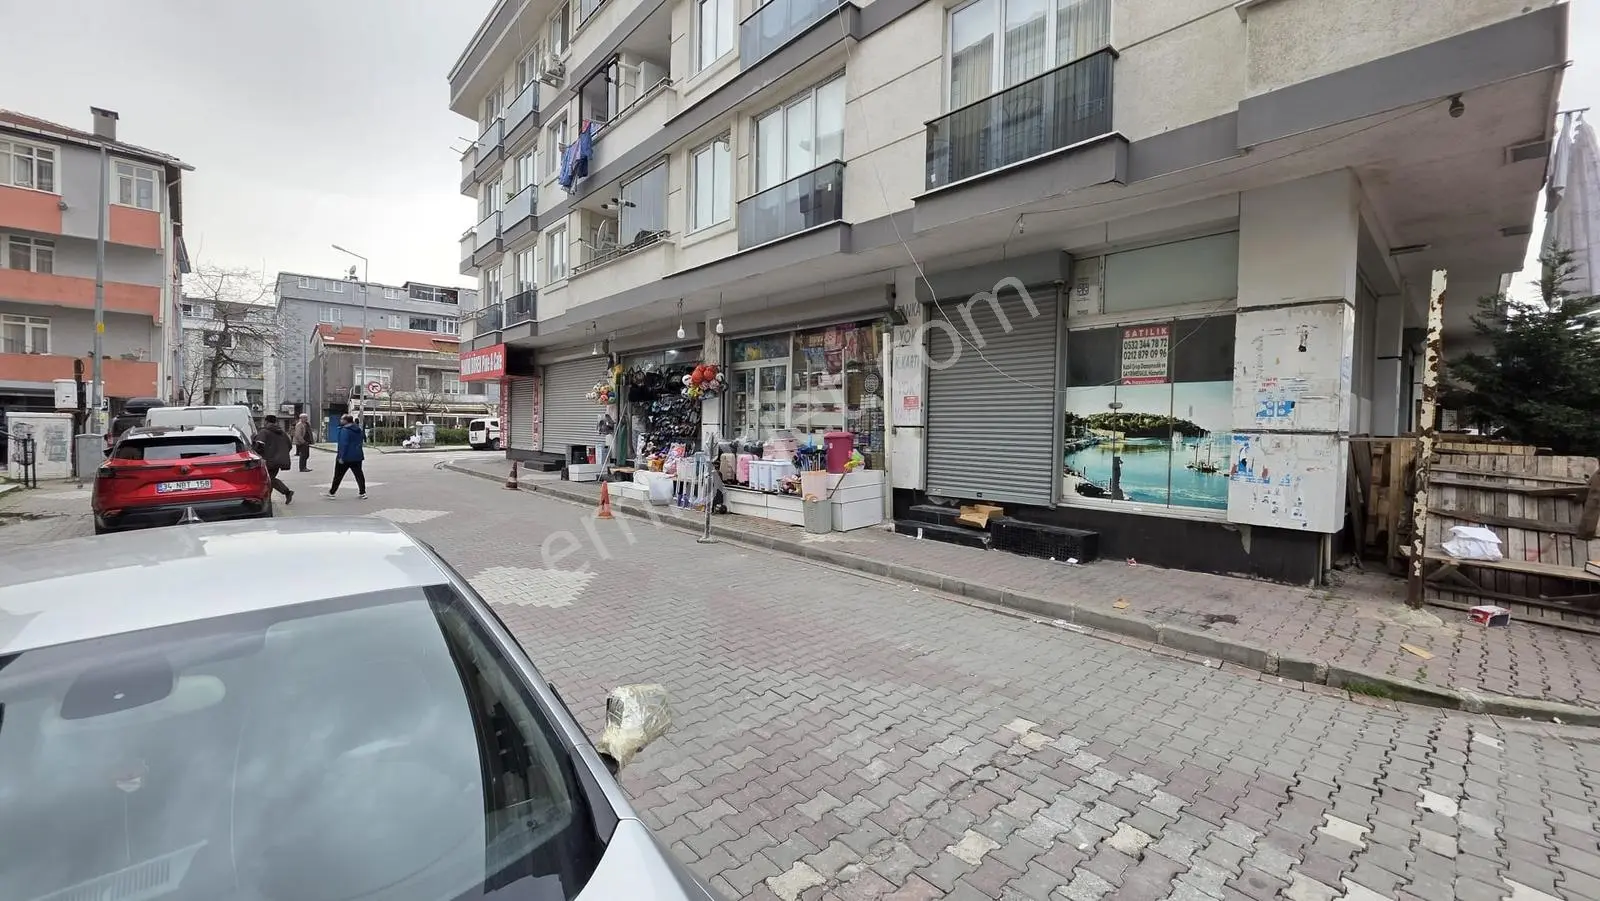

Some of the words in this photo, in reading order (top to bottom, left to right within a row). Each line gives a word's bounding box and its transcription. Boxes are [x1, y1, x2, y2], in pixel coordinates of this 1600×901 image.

[1124, 328, 1167, 338] SATILIK
[1124, 340, 1138, 350] 0532
[1139, 339, 1150, 348] 344
[1152, 338, 1159, 348] 78
[1160, 338, 1168, 346] 72
[1124, 350, 1137, 360] 0212
[1138, 349, 1149, 360] 879
[1150, 350, 1158, 358] 09
[1160, 348, 1166, 358] 96
